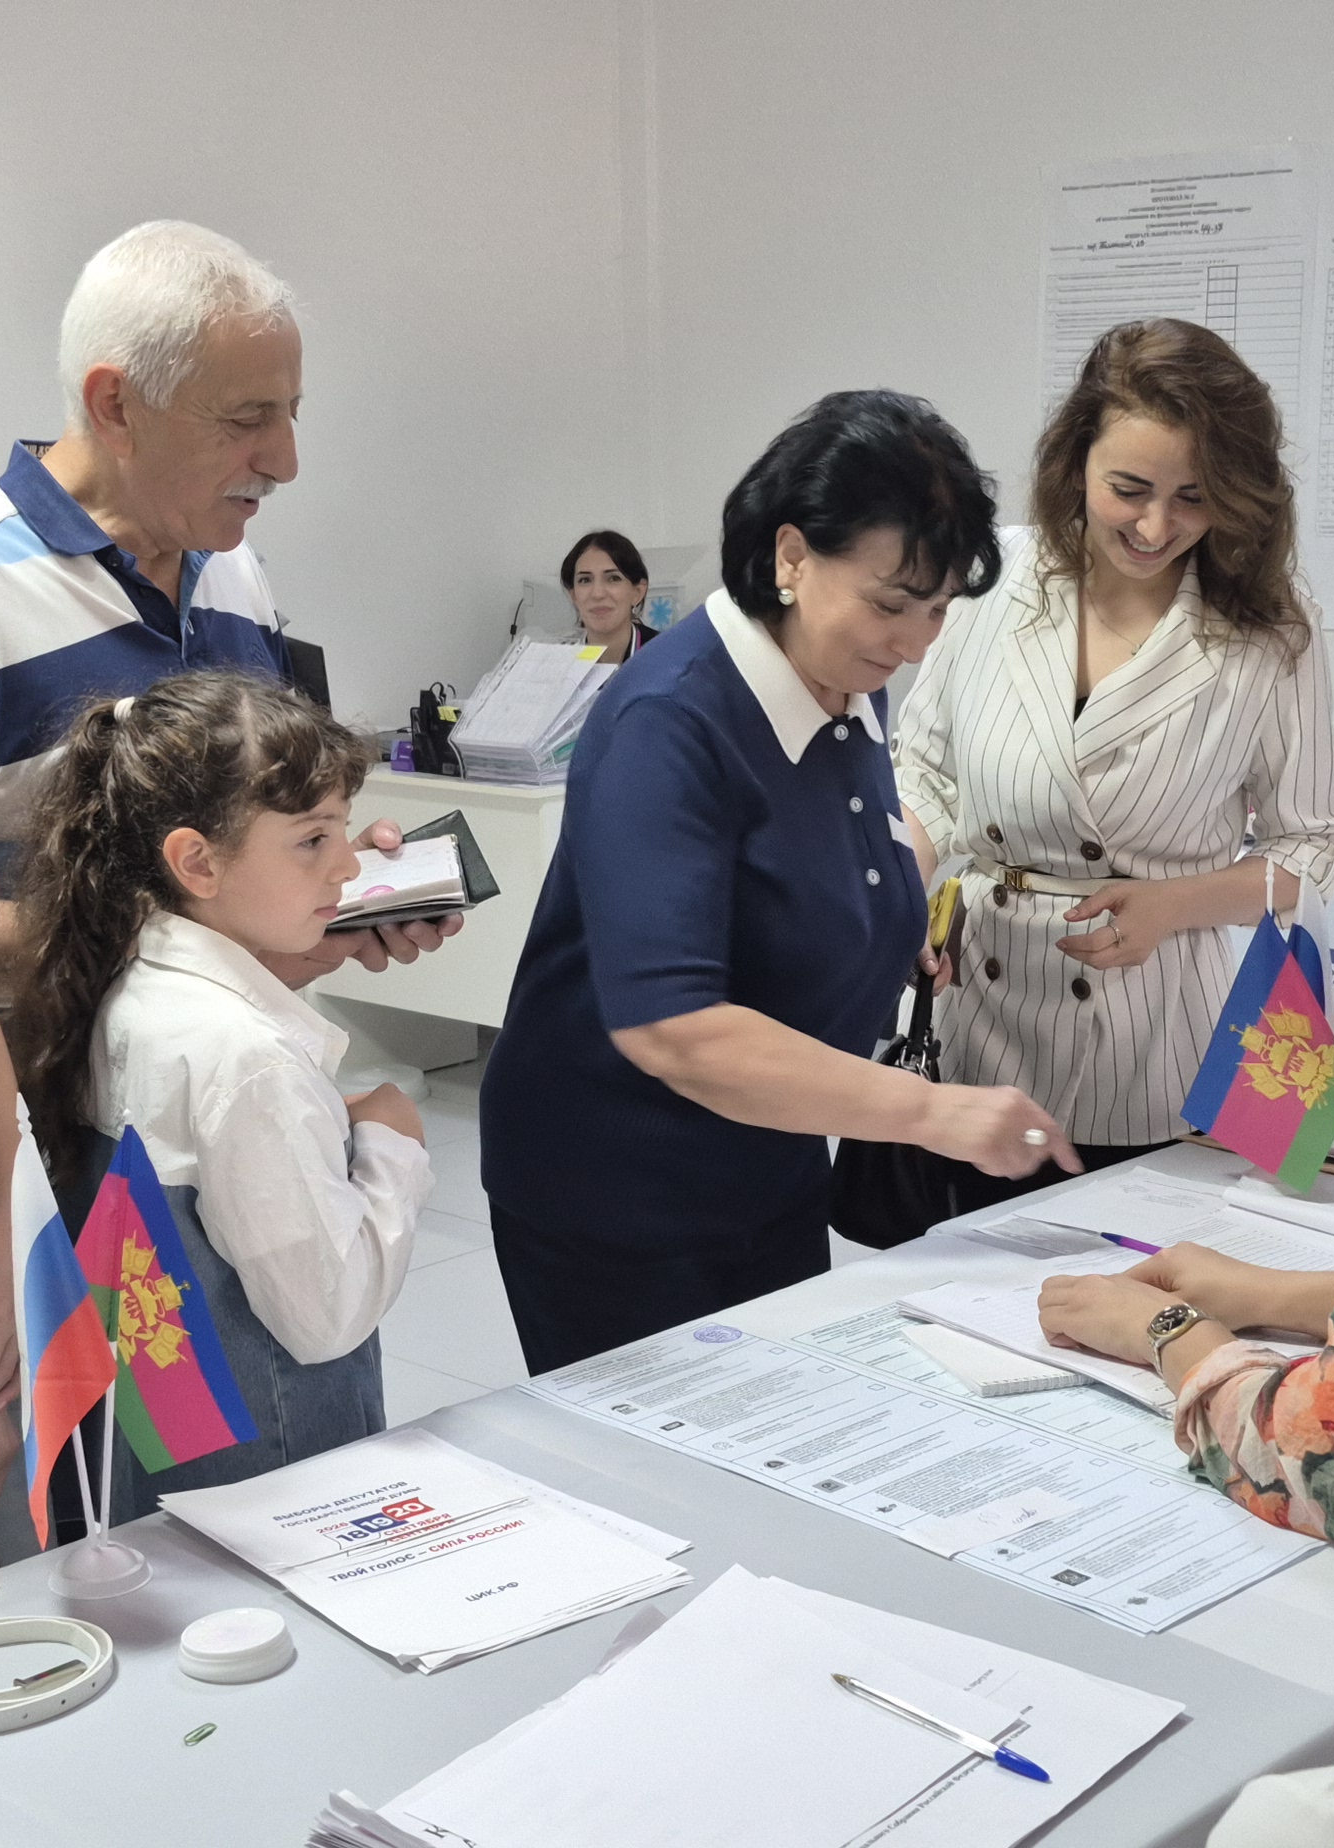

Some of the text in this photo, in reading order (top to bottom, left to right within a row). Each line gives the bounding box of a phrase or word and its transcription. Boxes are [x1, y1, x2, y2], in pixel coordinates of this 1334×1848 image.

[272, 1481, 408, 1521] ВЫБОРЫ ДЕПУТАТОВ
[280, 1486, 422, 1528] ГОСУДАРСТВЕННОЙ ДУМЫ
[316, 1522, 349, 1533] 2026
[335, 1502, 425, 1541] 18 19 20
[383, 1513, 451, 1536] СЕНТЯБРЯ
[327, 1567, 369, 1582] ТВОЙ
[369, 1553, 416, 1572] ГОЛОС
[428, 1538, 467, 1552] СИЛА
[466, 1520, 525, 1541] РОССИИ!
[465, 1581, 519, 1602] ЦИК.РФ
